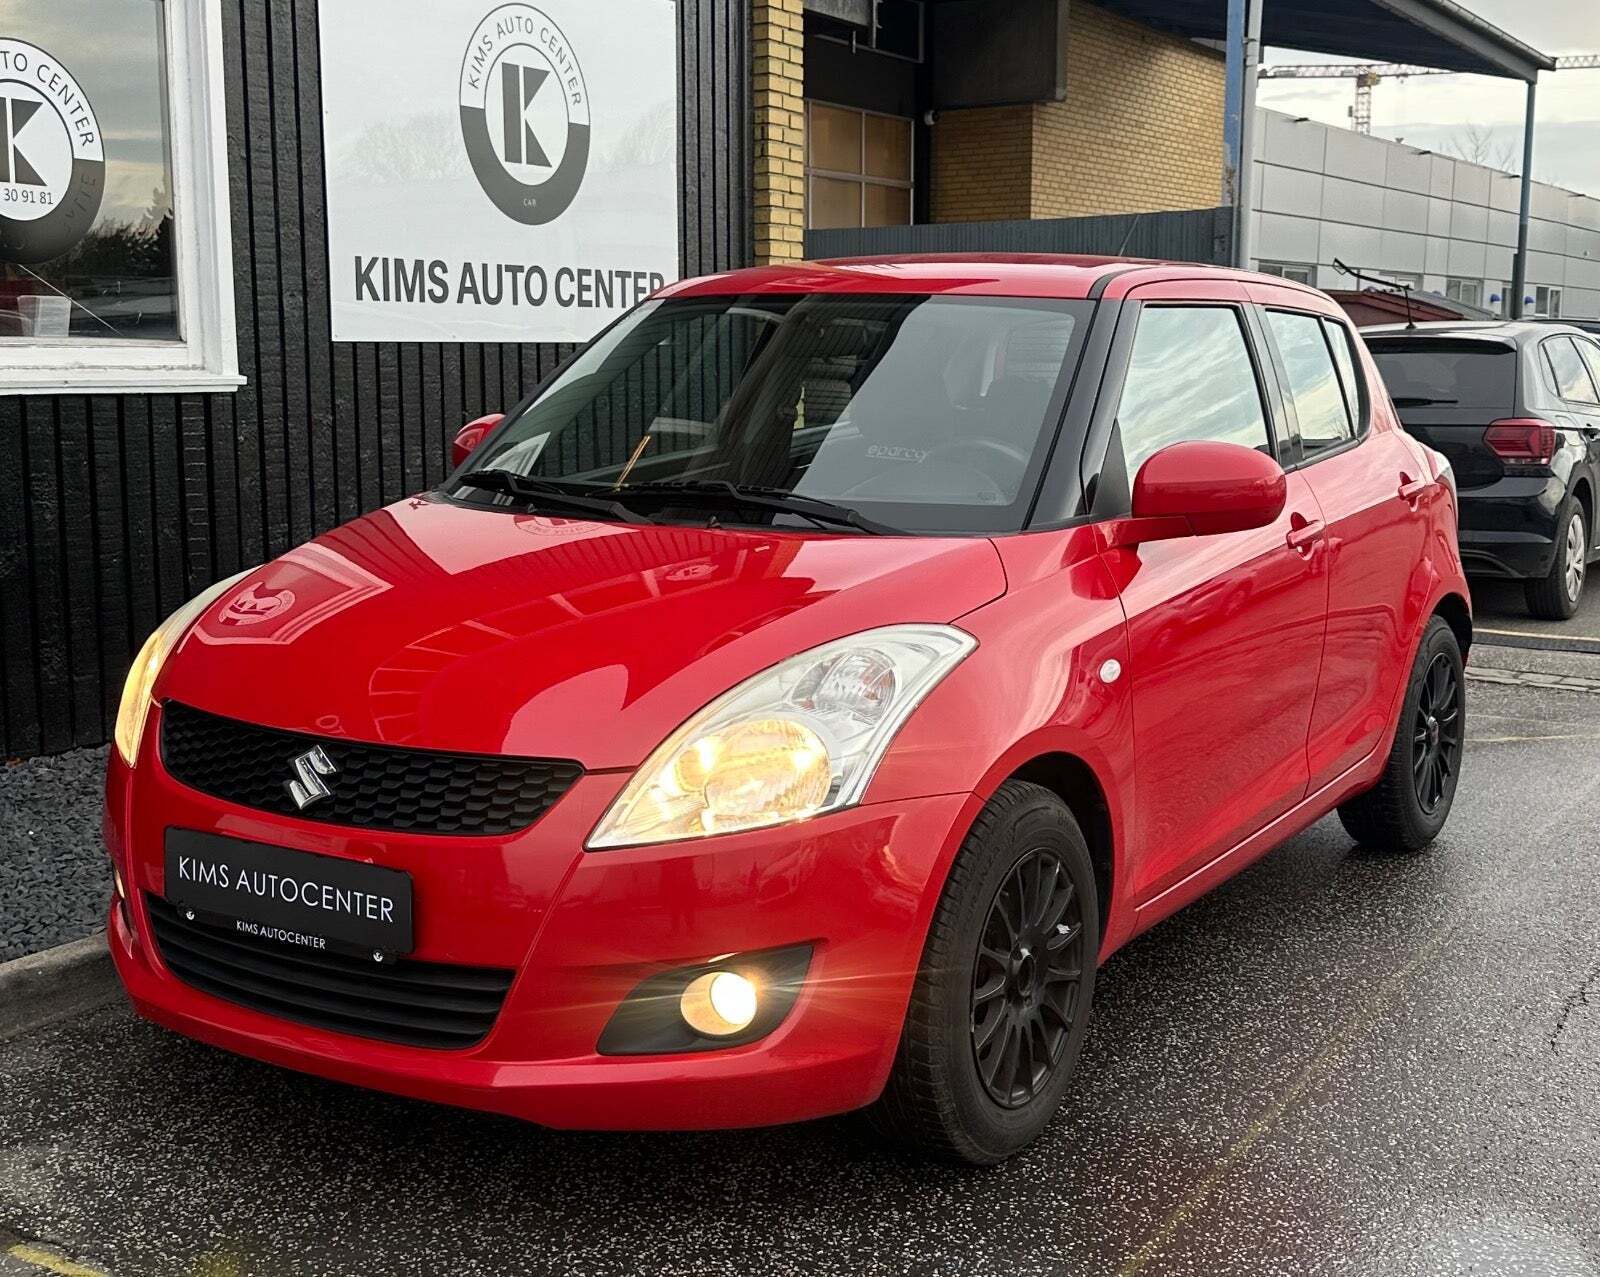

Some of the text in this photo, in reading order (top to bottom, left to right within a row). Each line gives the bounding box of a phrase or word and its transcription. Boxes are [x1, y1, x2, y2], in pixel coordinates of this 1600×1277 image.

[468, 16, 583, 106] KIMS AUTO CENTER
[36, 64, 95, 147] CENTER
[4, 187, 54, 205] 30 91 81
[354, 255, 450, 304] KIMS
[456, 262, 548, 308] AUTO
[178, 855, 394, 923] KIMS AUTOCENTER
[236, 919, 326, 950] KIMS AUTOCENTER
